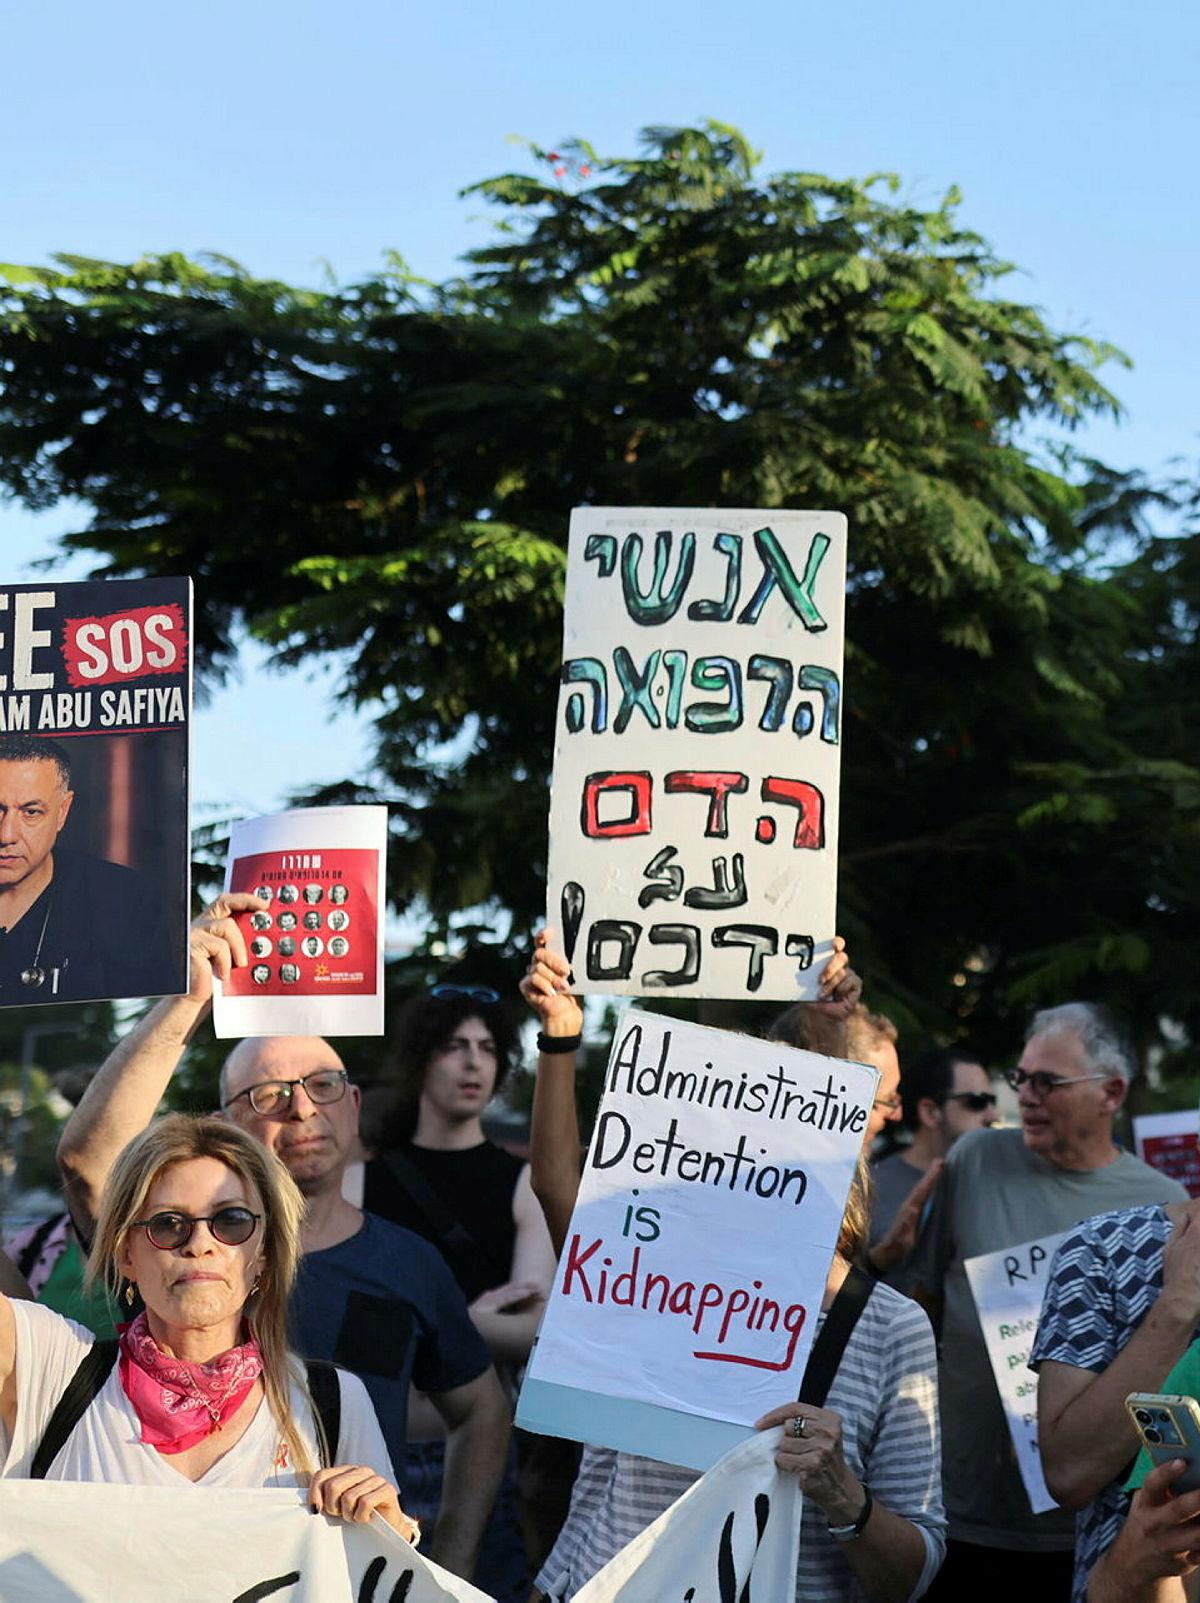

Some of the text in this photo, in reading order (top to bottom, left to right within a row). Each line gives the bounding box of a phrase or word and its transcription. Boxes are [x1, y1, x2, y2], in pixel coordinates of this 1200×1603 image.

[584, 527, 828, 632] אנשי
[0, 590, 56, 691] E
[75, 614, 176, 679] SOS
[38, 692, 92, 729] ABU
[100, 687, 185, 727] SAFIYA
[560, 646, 839, 745] הרפואה
[581, 770, 826, 850] הדם
[638, 845, 749, 910] על
[608, 1024, 868, 1134] Administrative
[592, 1111, 808, 1205] Detention
[622, 1189, 661, 1242] is
[562, 1233, 807, 1372] Kidnapping
